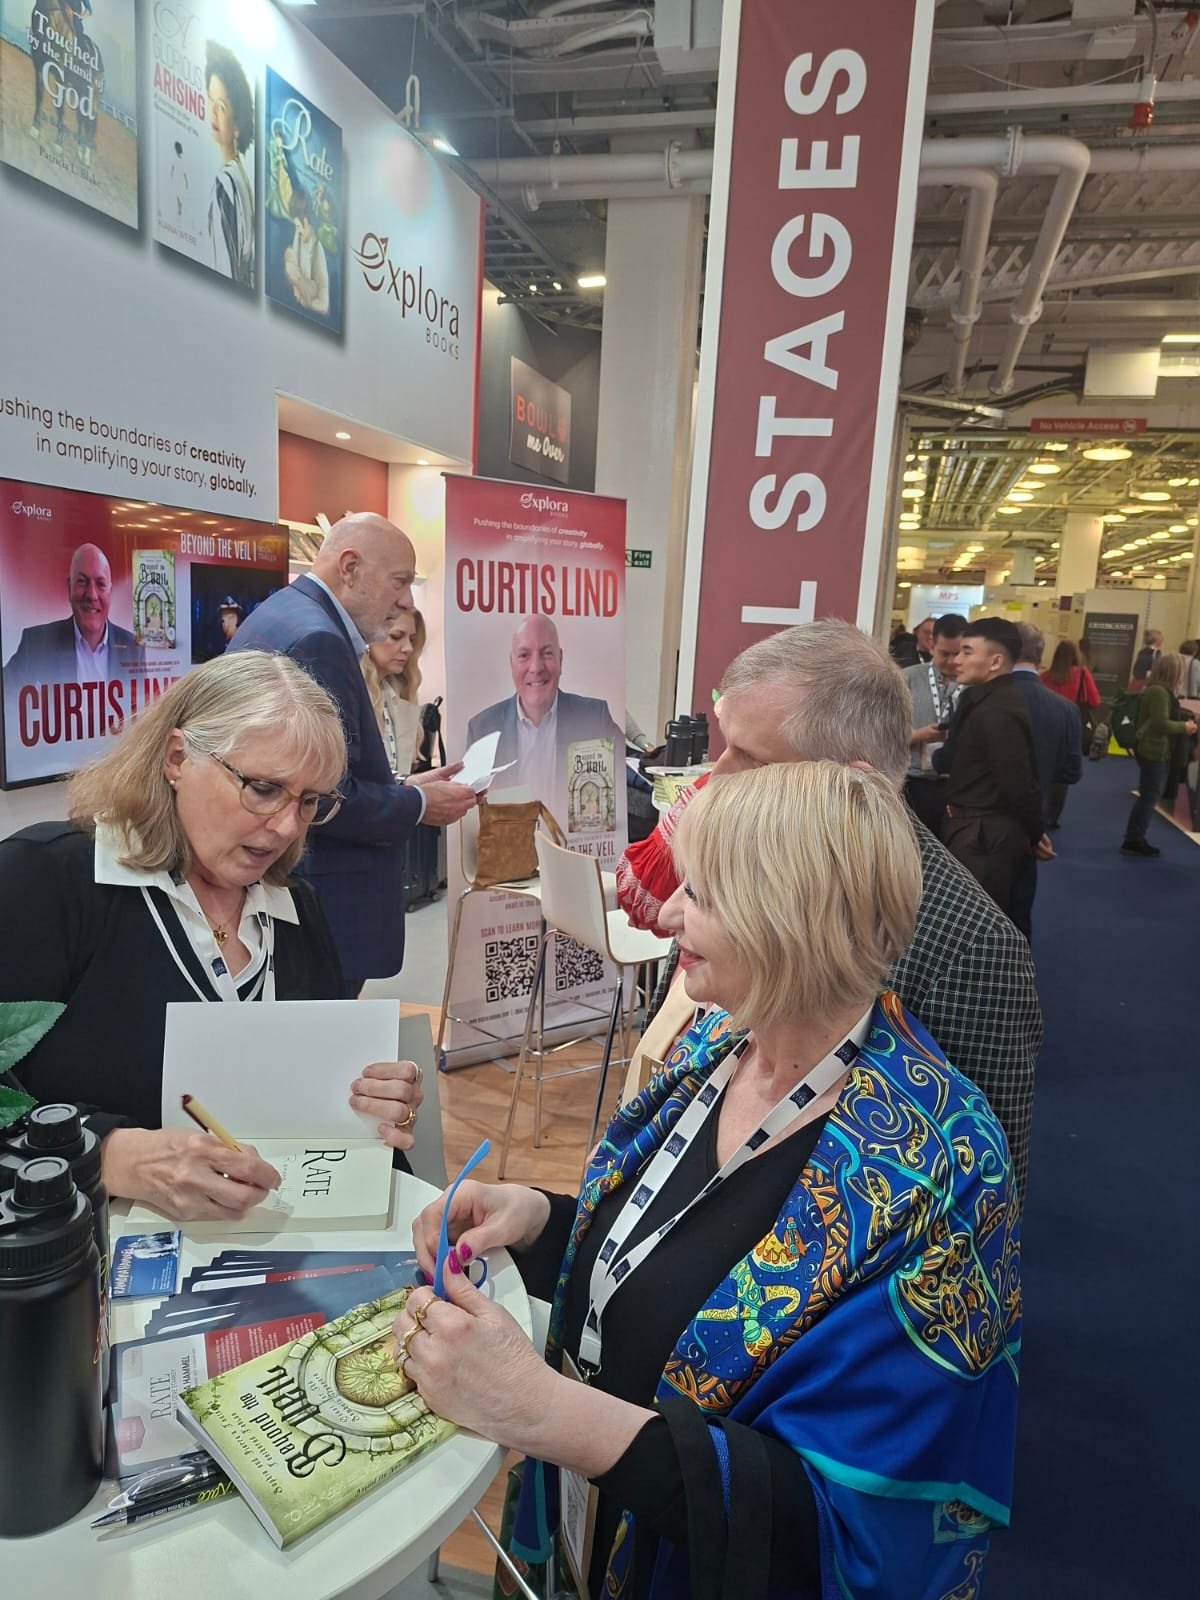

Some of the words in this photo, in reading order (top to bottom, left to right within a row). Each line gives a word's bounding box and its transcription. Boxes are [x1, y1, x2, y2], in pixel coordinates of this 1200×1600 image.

[26, 28, 39, 49] by
[43, 41, 60, 62] the
[64, 52, 92, 82] Hand
[34, 10, 100, 71] Touched
[42, 61, 96, 120] God
[154, 62, 205, 121] ARISING
[271, 98, 333, 180] Rate
[351, 233, 459, 339] Explora
[749, 48, 867, 532] STAGES
[426, 328, 459, 360] BOOKS
[36, 432, 51, 453] in
[56, 442, 138, 475] amplifying
[141, 459, 171, 477] your
[174, 466, 208, 488] story,
[209, 472, 257, 498] globally.
[58, 410, 85, 432] the
[90, 416, 171, 454] boundaries
[175, 440, 188, 457] of
[190, 446, 246, 474] creativity
[11, 500, 52, 518] Explora
[473, 518, 501, 530] Pushing
[501, 521, 513, 529] the
[513, 523, 550, 533] boundaries
[558, 528, 588, 538] creativity
[520, 492, 569, 513] Explora
[180, 533, 215, 557] BEYOND
[217, 538, 232, 559] THE
[234, 540, 252, 560] VEIL
[513, 534, 548, 545] amplifying
[456, 557, 556, 617] CURTIS
[562, 566, 618, 618] LIND
[18, 681, 124, 748] CURTIS
[597, 840, 616, 857] VEIL
[480, 927, 496, 938] SCAN
[497, 925, 504, 934] TO
[506, 923, 524, 933] LEARN
[303, 1148, 347, 1197] RATE
[150, 1372, 172, 1420] RATE
[181, 1355, 190, 1386] HAMMEL
[239, 1392, 259, 1412] the
[250, 1411, 347, 1479] Beyond
